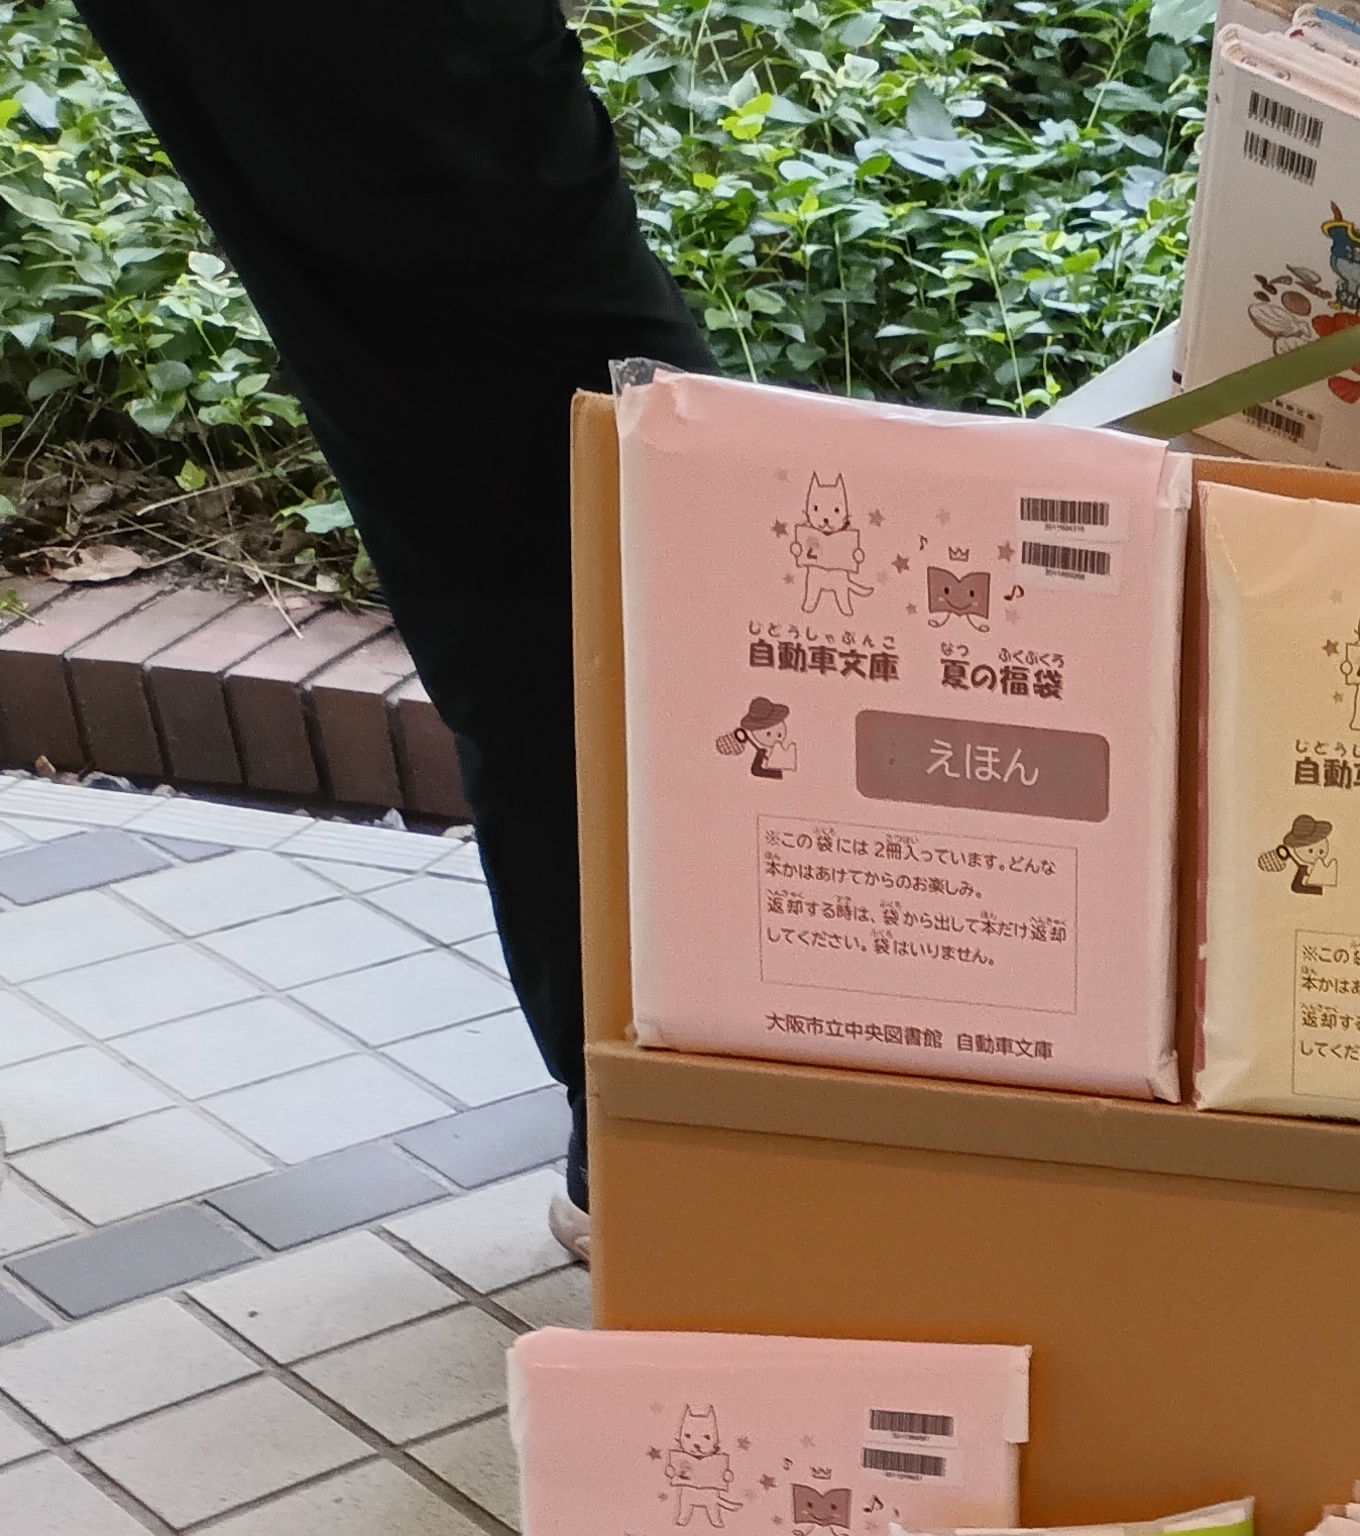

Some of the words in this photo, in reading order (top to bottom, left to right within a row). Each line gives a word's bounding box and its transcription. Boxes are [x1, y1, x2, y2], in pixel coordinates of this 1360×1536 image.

[749, 638, 899, 682] 自動車文庫
[940, 657, 1065, 699] 夏の福袋
[926, 739, 1039, 786] えほん
[765, 1011, 943, 1050] 大阪市立中央図書館
[956, 1033, 1053, 1060] 自動車文庫
